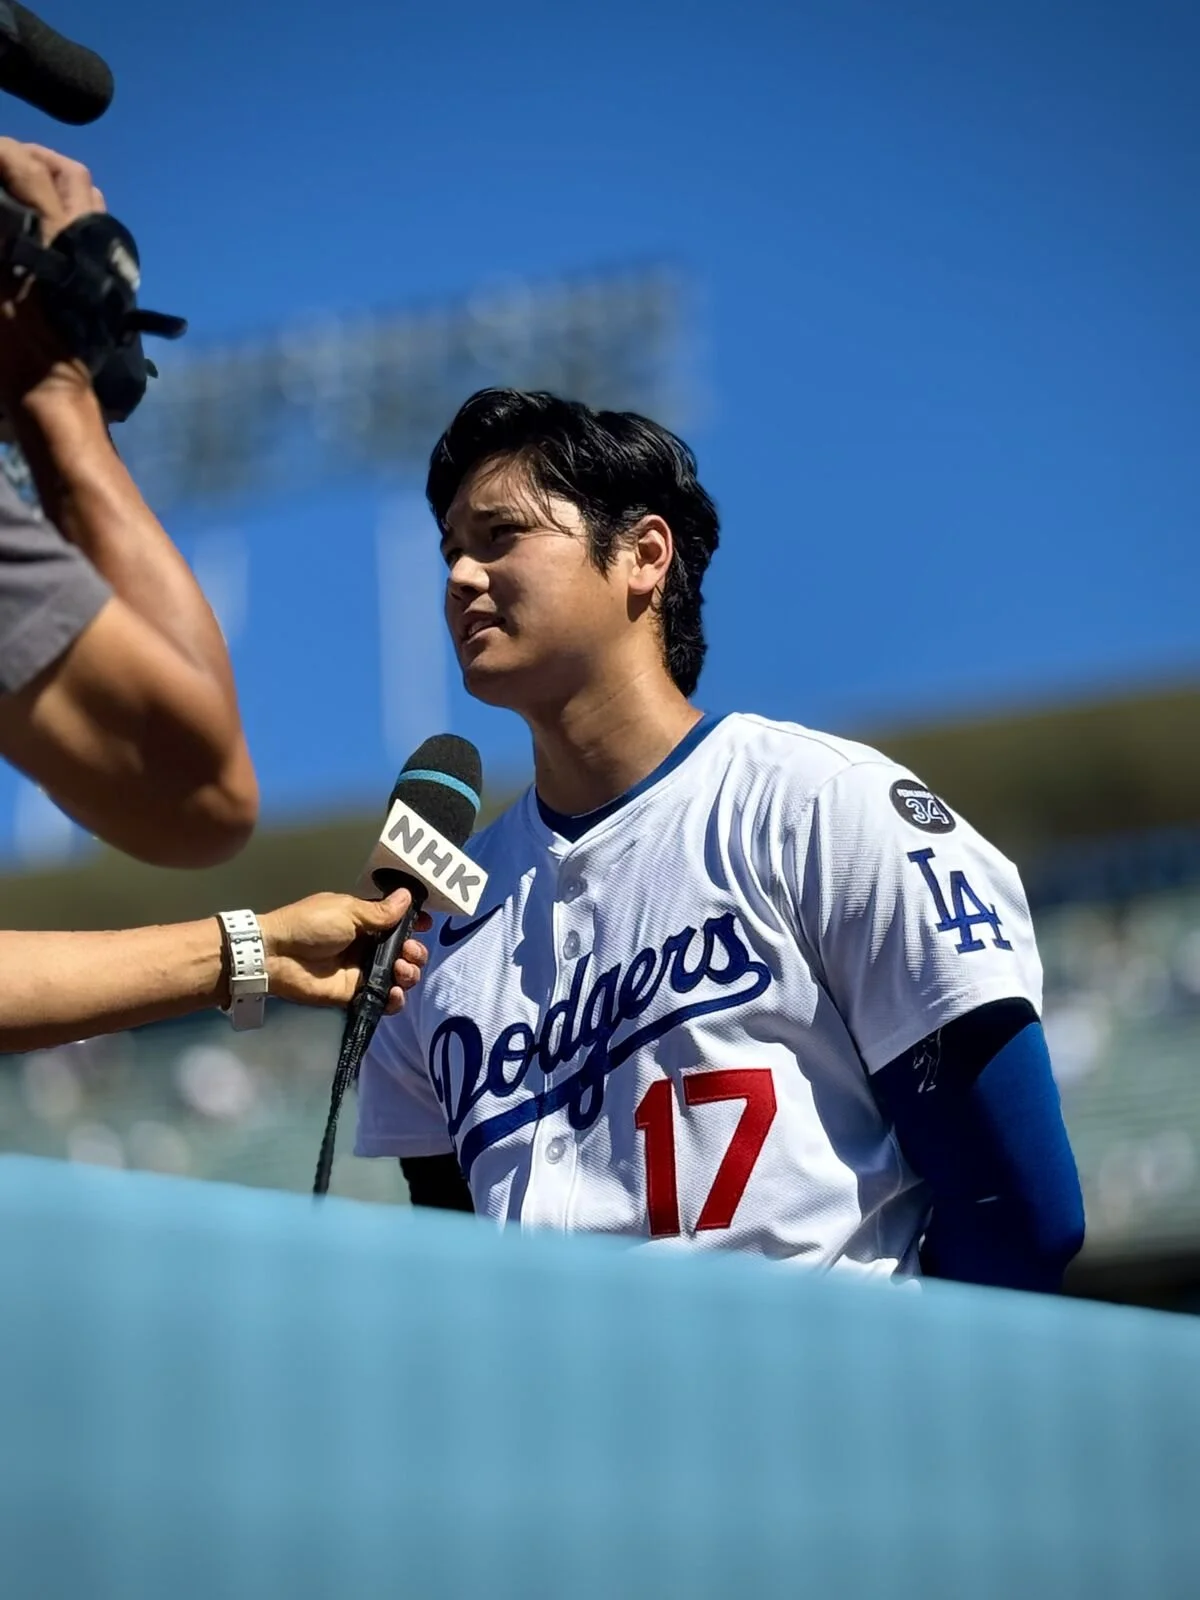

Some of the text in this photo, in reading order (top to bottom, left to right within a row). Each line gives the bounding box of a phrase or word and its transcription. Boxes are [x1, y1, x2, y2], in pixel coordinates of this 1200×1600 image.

[388, 815, 480, 902] NHK
[905, 798, 950, 824] 34
[907, 847, 1014, 954] LA
[429, 912, 771, 1136] Dodgers
[634, 1068, 778, 1237] 17
